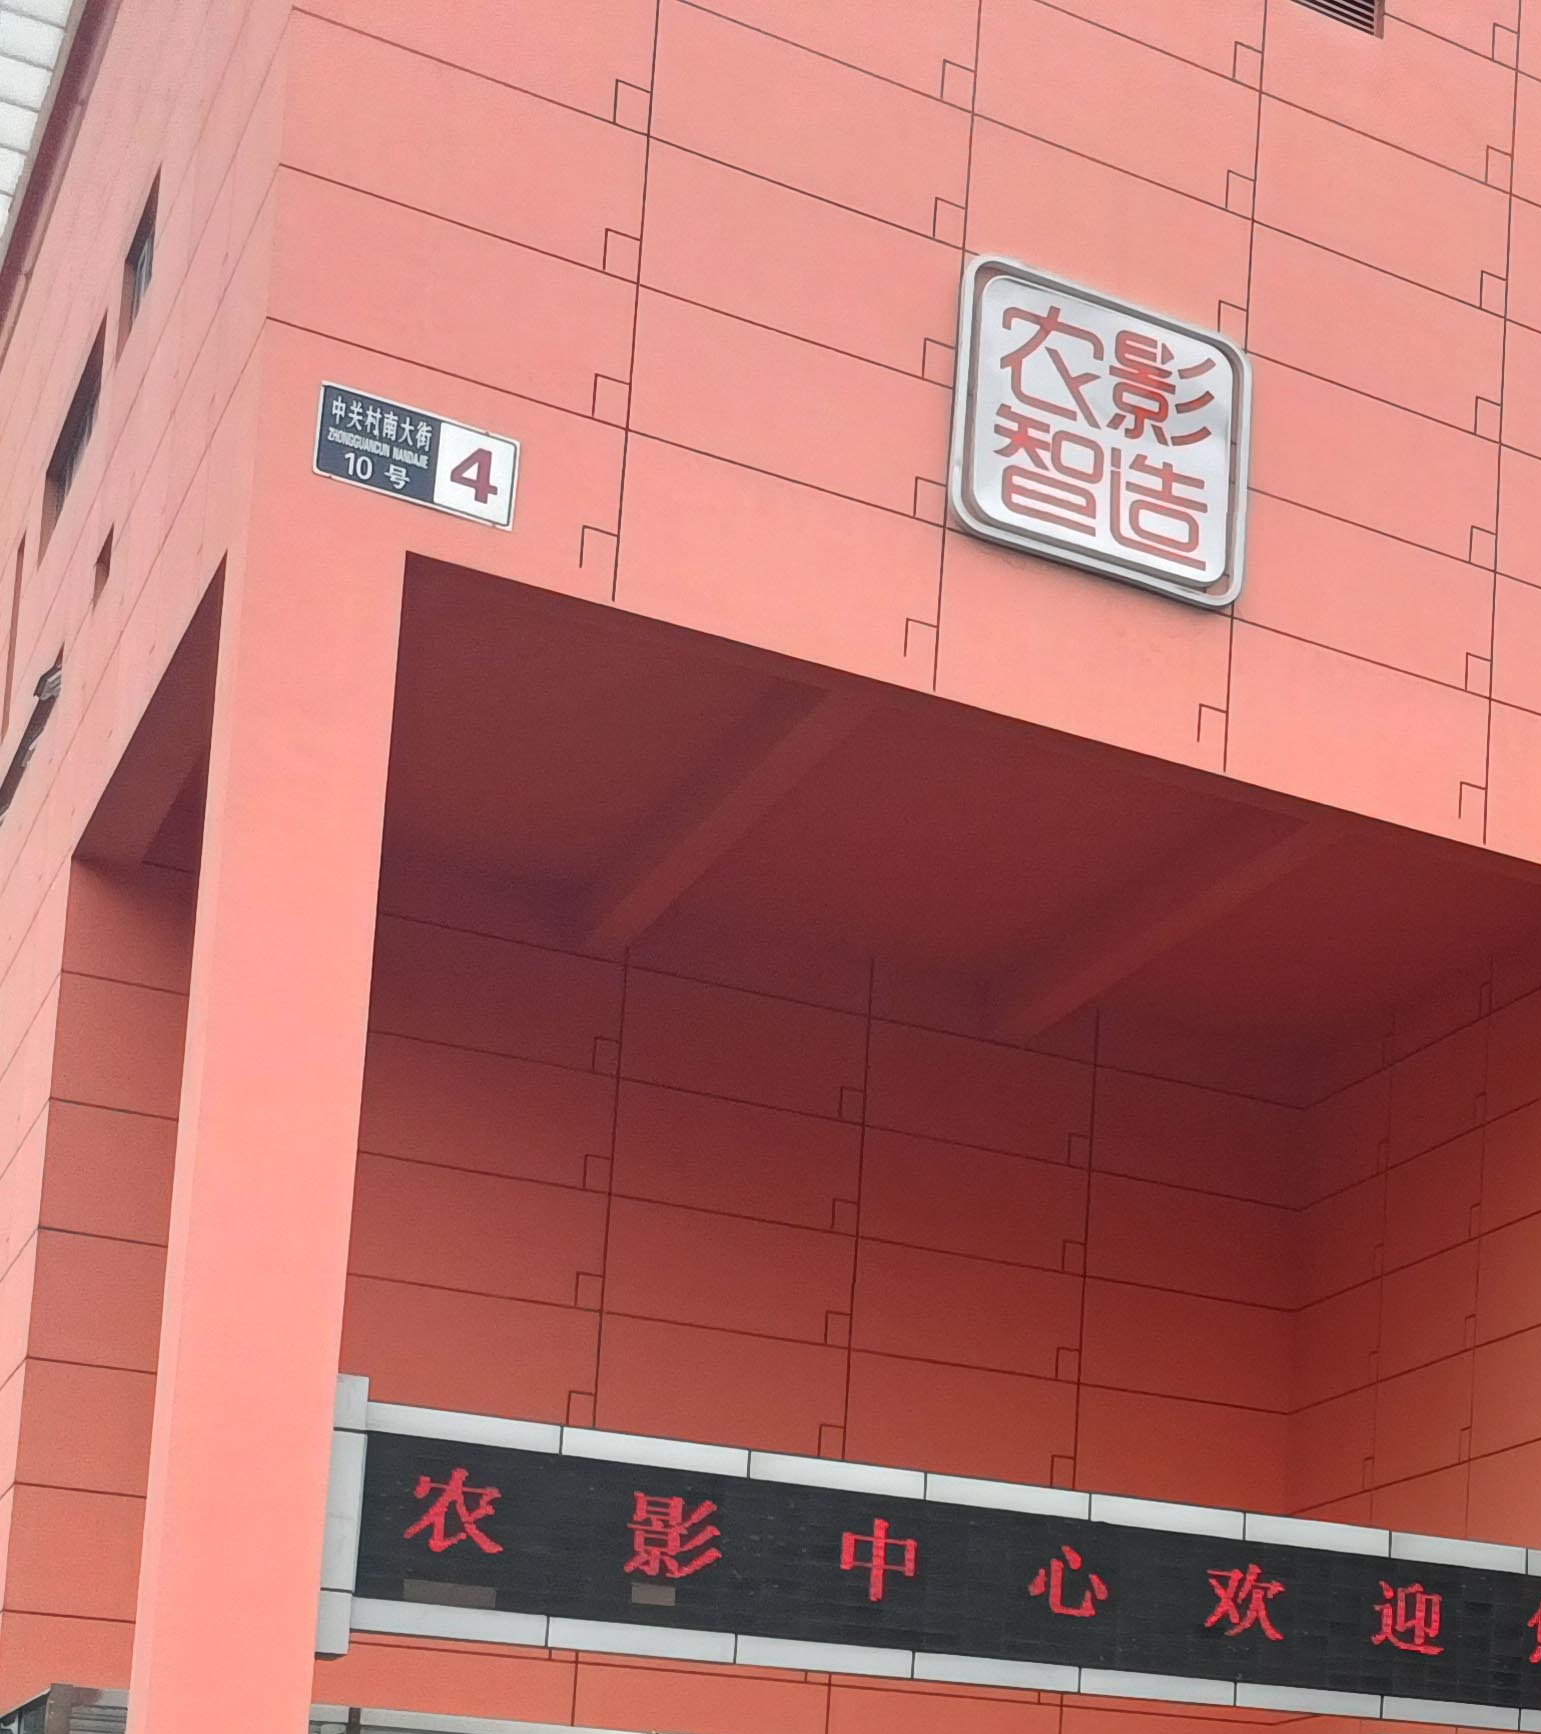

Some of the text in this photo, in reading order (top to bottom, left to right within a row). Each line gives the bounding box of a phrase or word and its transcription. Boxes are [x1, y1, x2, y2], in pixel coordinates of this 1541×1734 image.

[331, 395, 433, 452] 中关村南大街
[999, 304, 1217, 447] 农影
[450, 447, 498, 505] 4
[992, 402, 1209, 572] 智造
